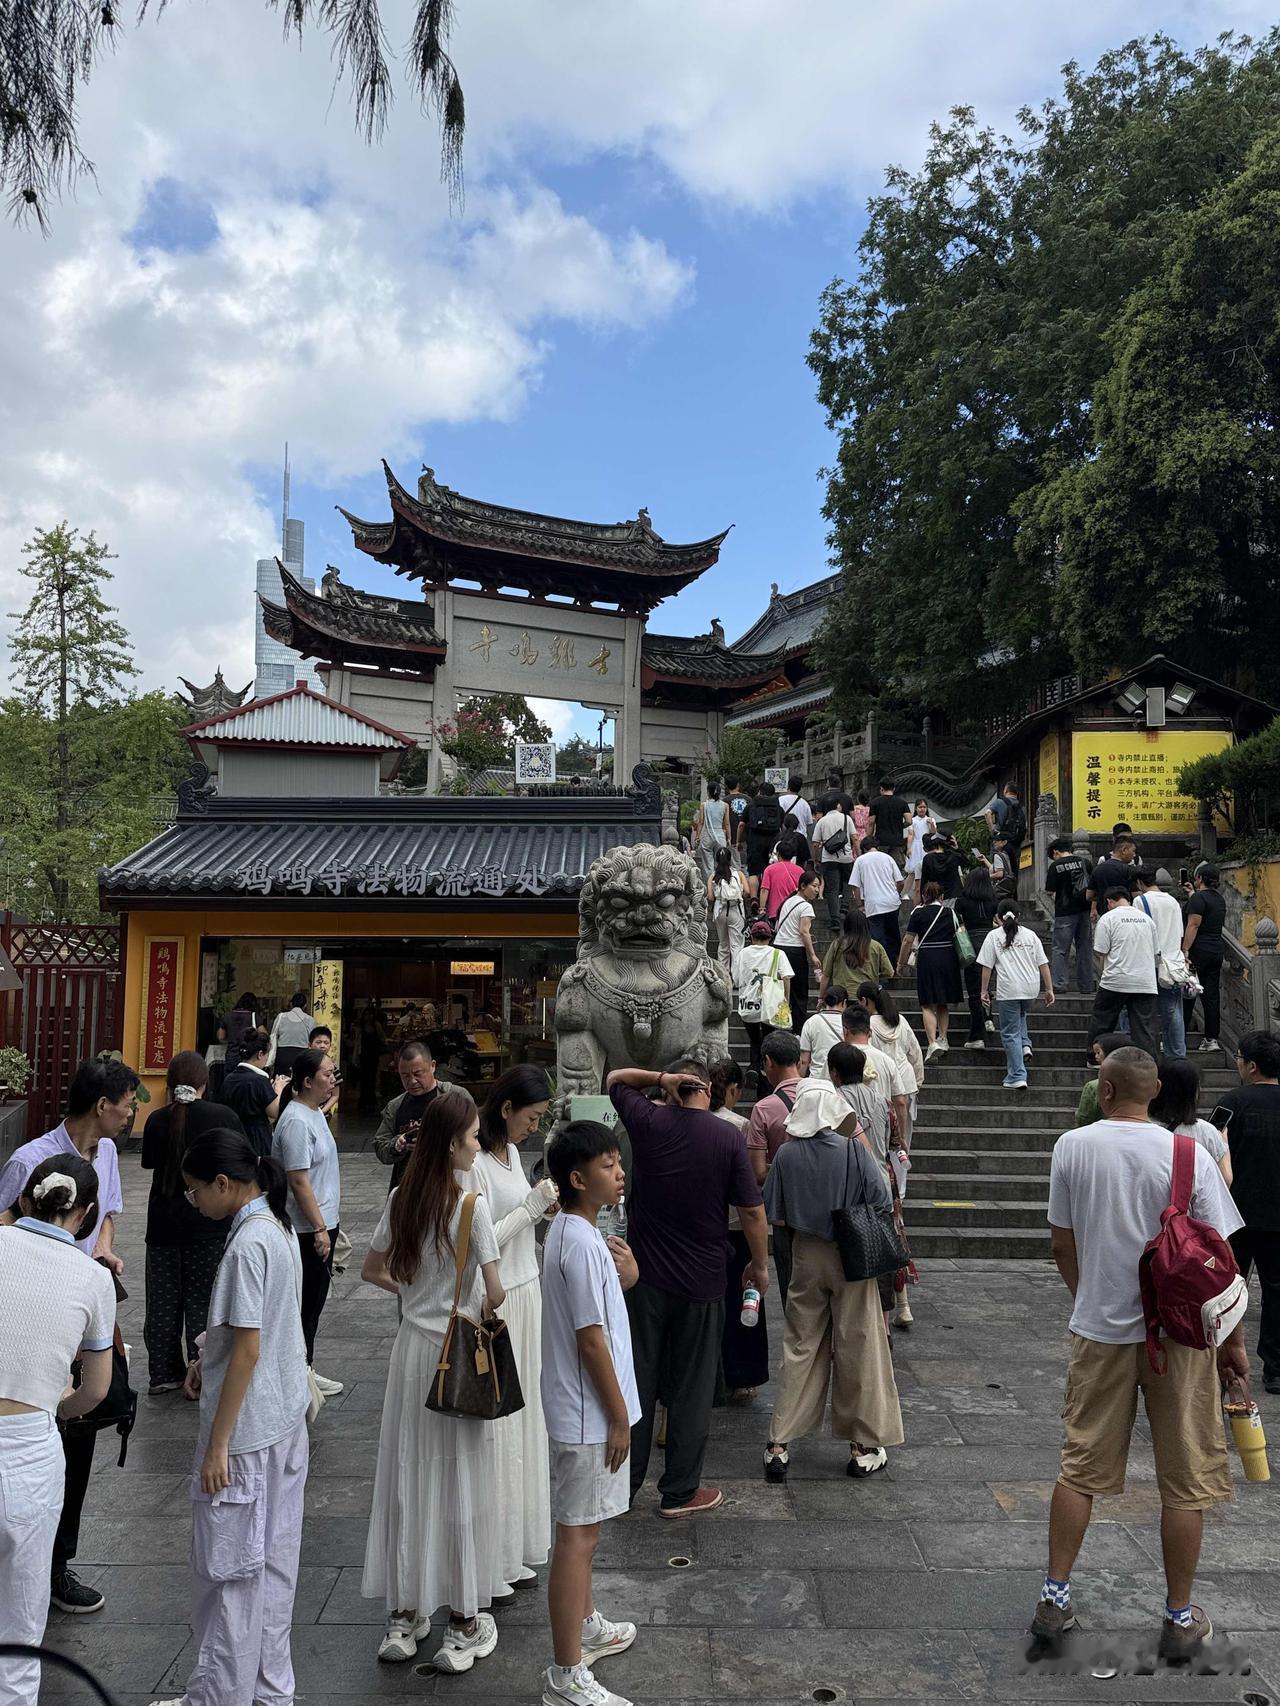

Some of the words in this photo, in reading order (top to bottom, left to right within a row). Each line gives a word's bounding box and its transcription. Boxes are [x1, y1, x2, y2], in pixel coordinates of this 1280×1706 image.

[1086, 756, 1102, 819] 温馨提示
[237, 859, 549, 896] 鸡鸣寺法物流通处
